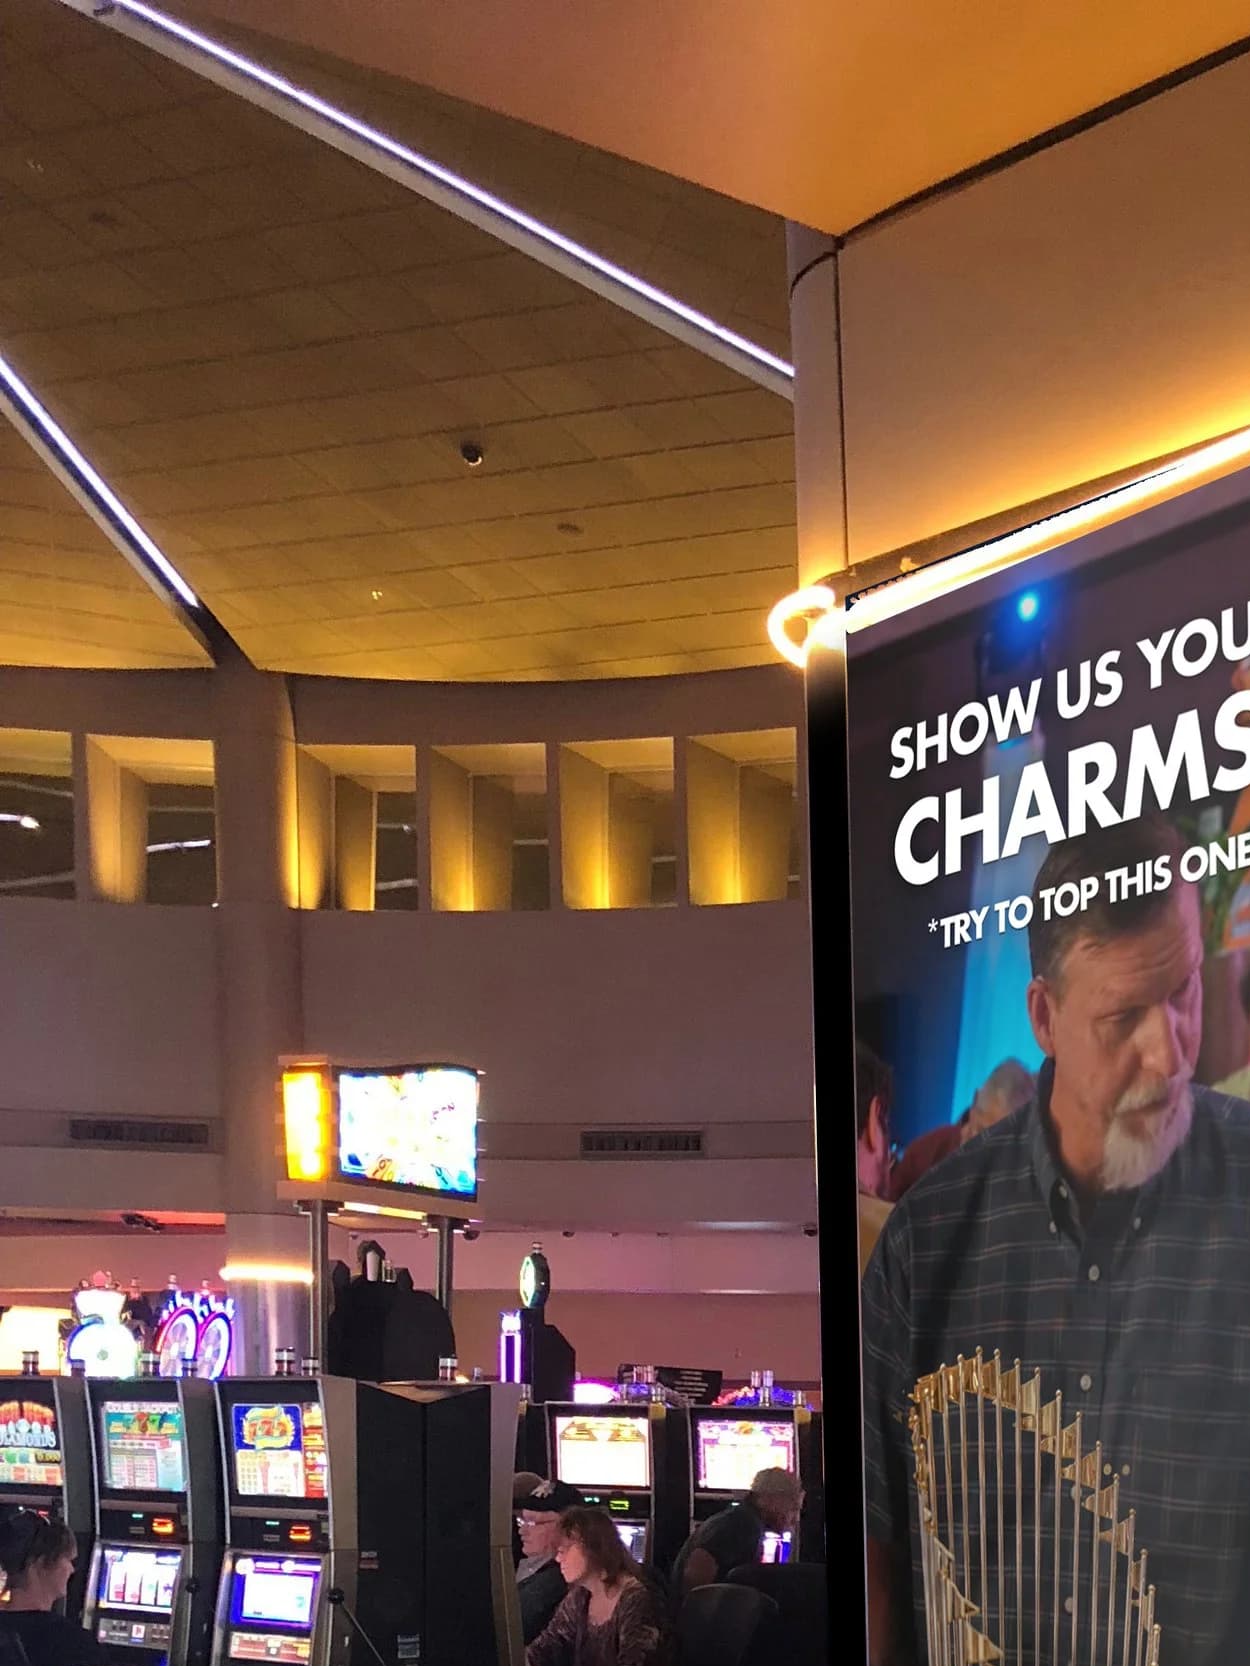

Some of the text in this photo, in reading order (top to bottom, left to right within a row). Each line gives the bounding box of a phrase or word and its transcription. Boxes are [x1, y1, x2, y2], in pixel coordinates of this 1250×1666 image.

[889, 678, 1042, 779] SHOW
[1057, 650, 1123, 720] US
[994, 895, 1034, 933] TO
[1039, 876, 1099, 921] TOP
[1104, 855, 1172, 903] THIS
